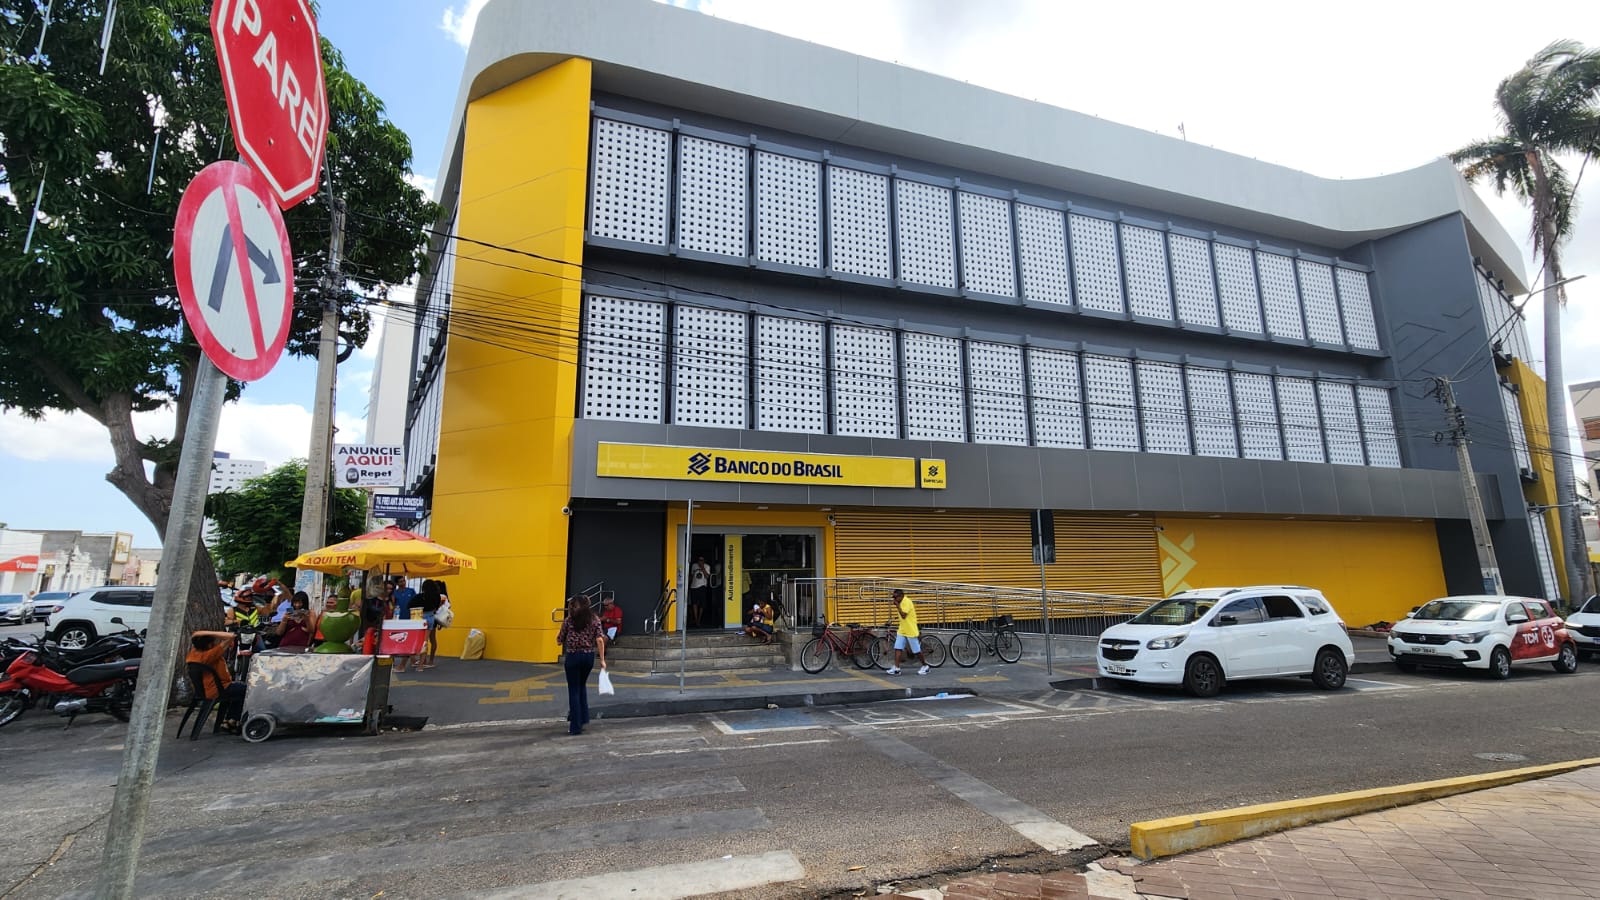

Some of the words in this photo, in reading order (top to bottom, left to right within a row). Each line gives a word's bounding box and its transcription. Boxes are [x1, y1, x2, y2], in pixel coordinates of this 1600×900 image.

[232, 0, 317, 158] PARE
[338, 446, 401, 456] ANUNCIE
[345, 455, 393, 466] AQUI!
[714, 456, 769, 476] BANCO
[771, 462, 792, 476] DO
[793, 460, 844, 478] BRASIL
[360, 469, 392, 478] Repet
[304, 557, 333, 565] AQUI
[336, 555, 357, 565] TEM
[1522, 632, 1539, 645] TCM
